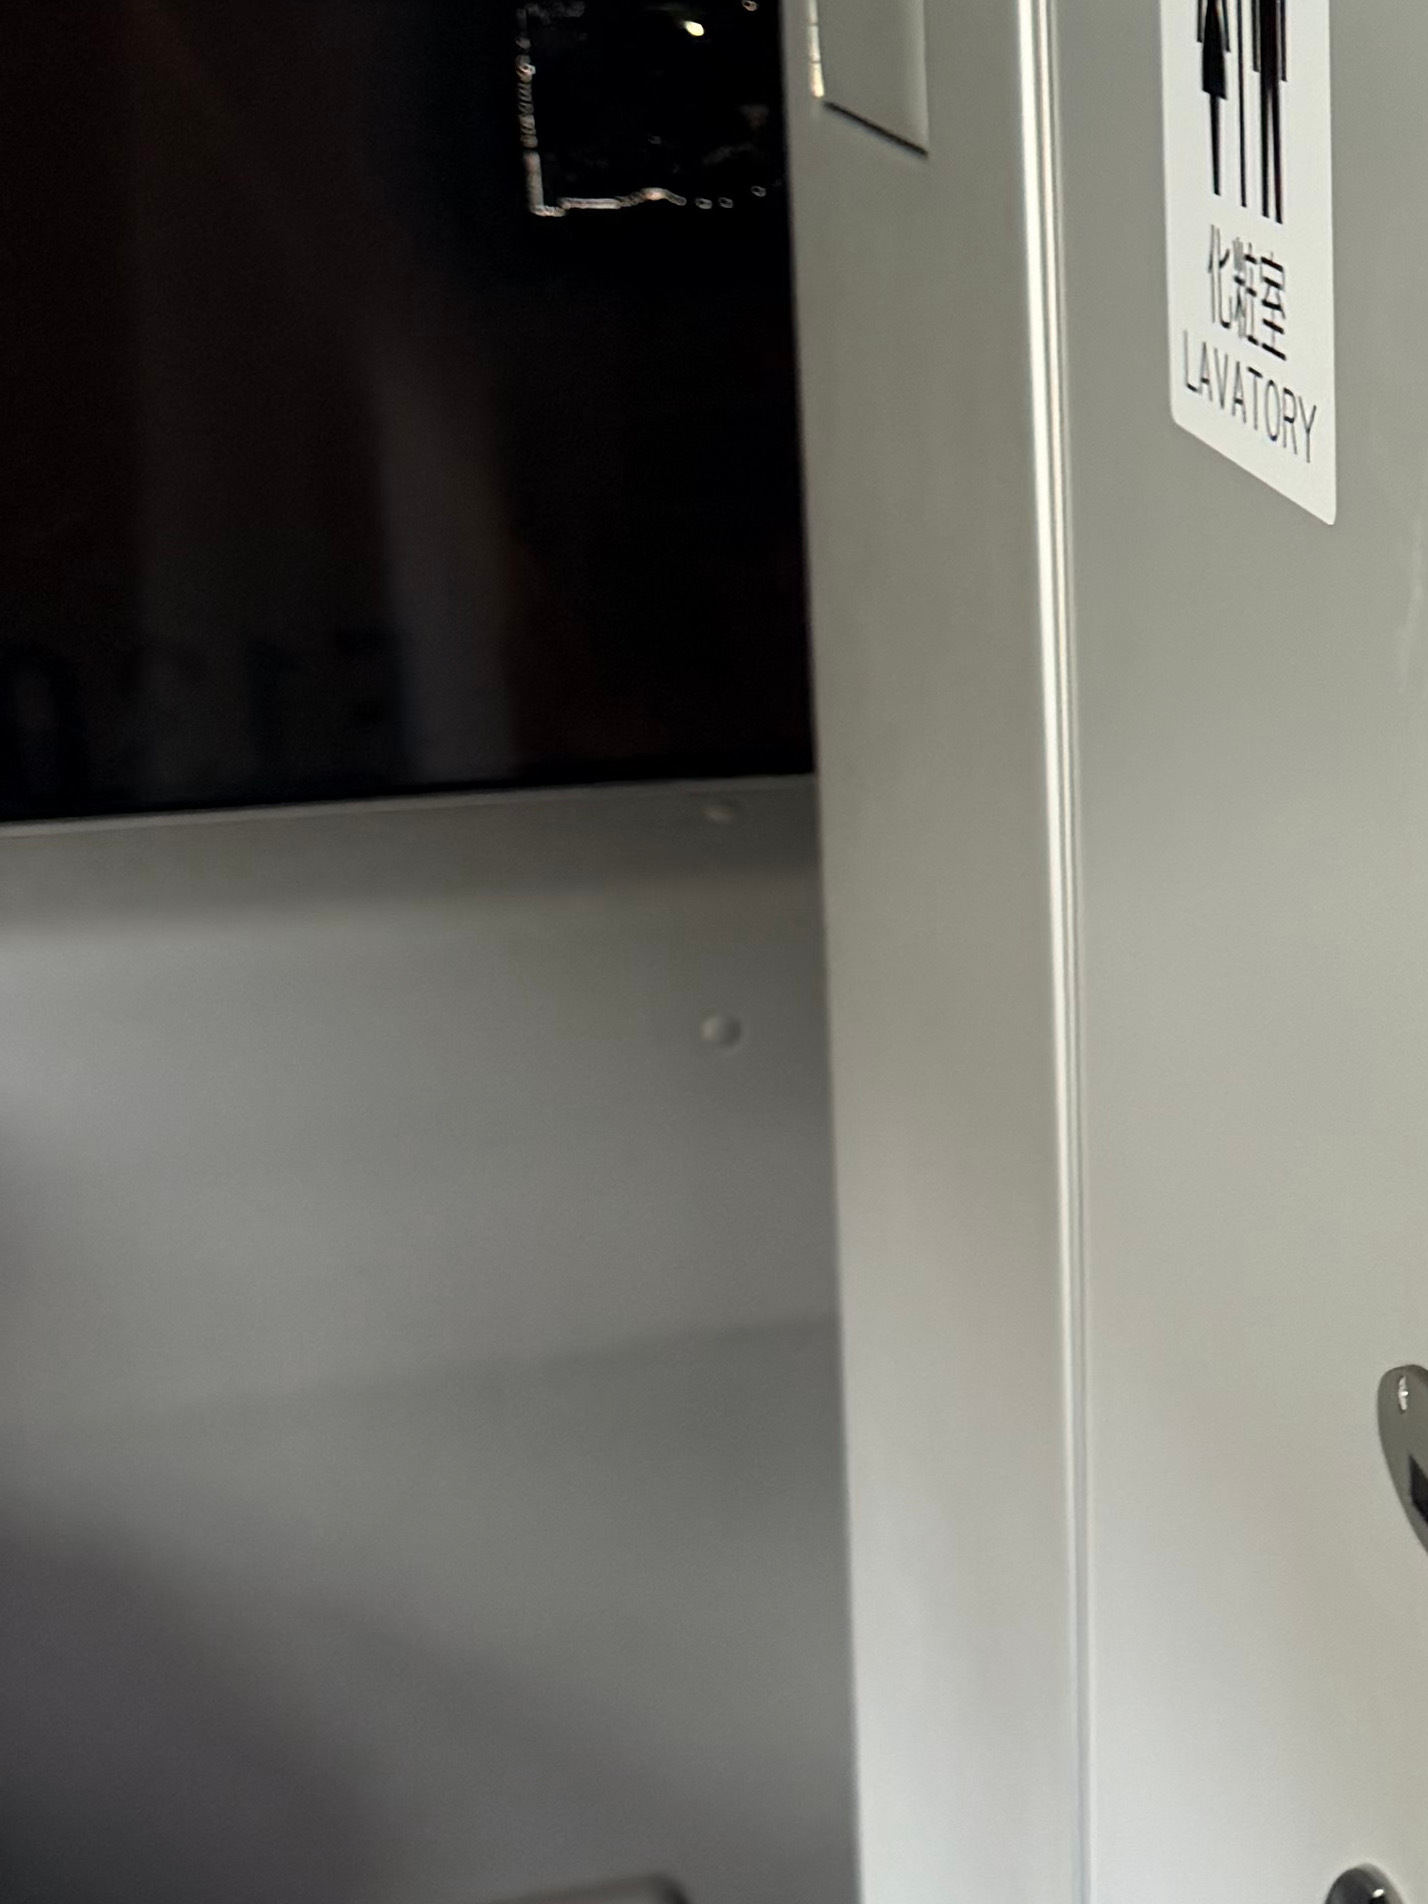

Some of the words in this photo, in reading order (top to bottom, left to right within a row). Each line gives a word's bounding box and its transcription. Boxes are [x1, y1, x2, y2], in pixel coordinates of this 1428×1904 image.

[1208, 223, 1286, 362] 化粧室
[1182, 329, 1317, 464] LAVATORY
